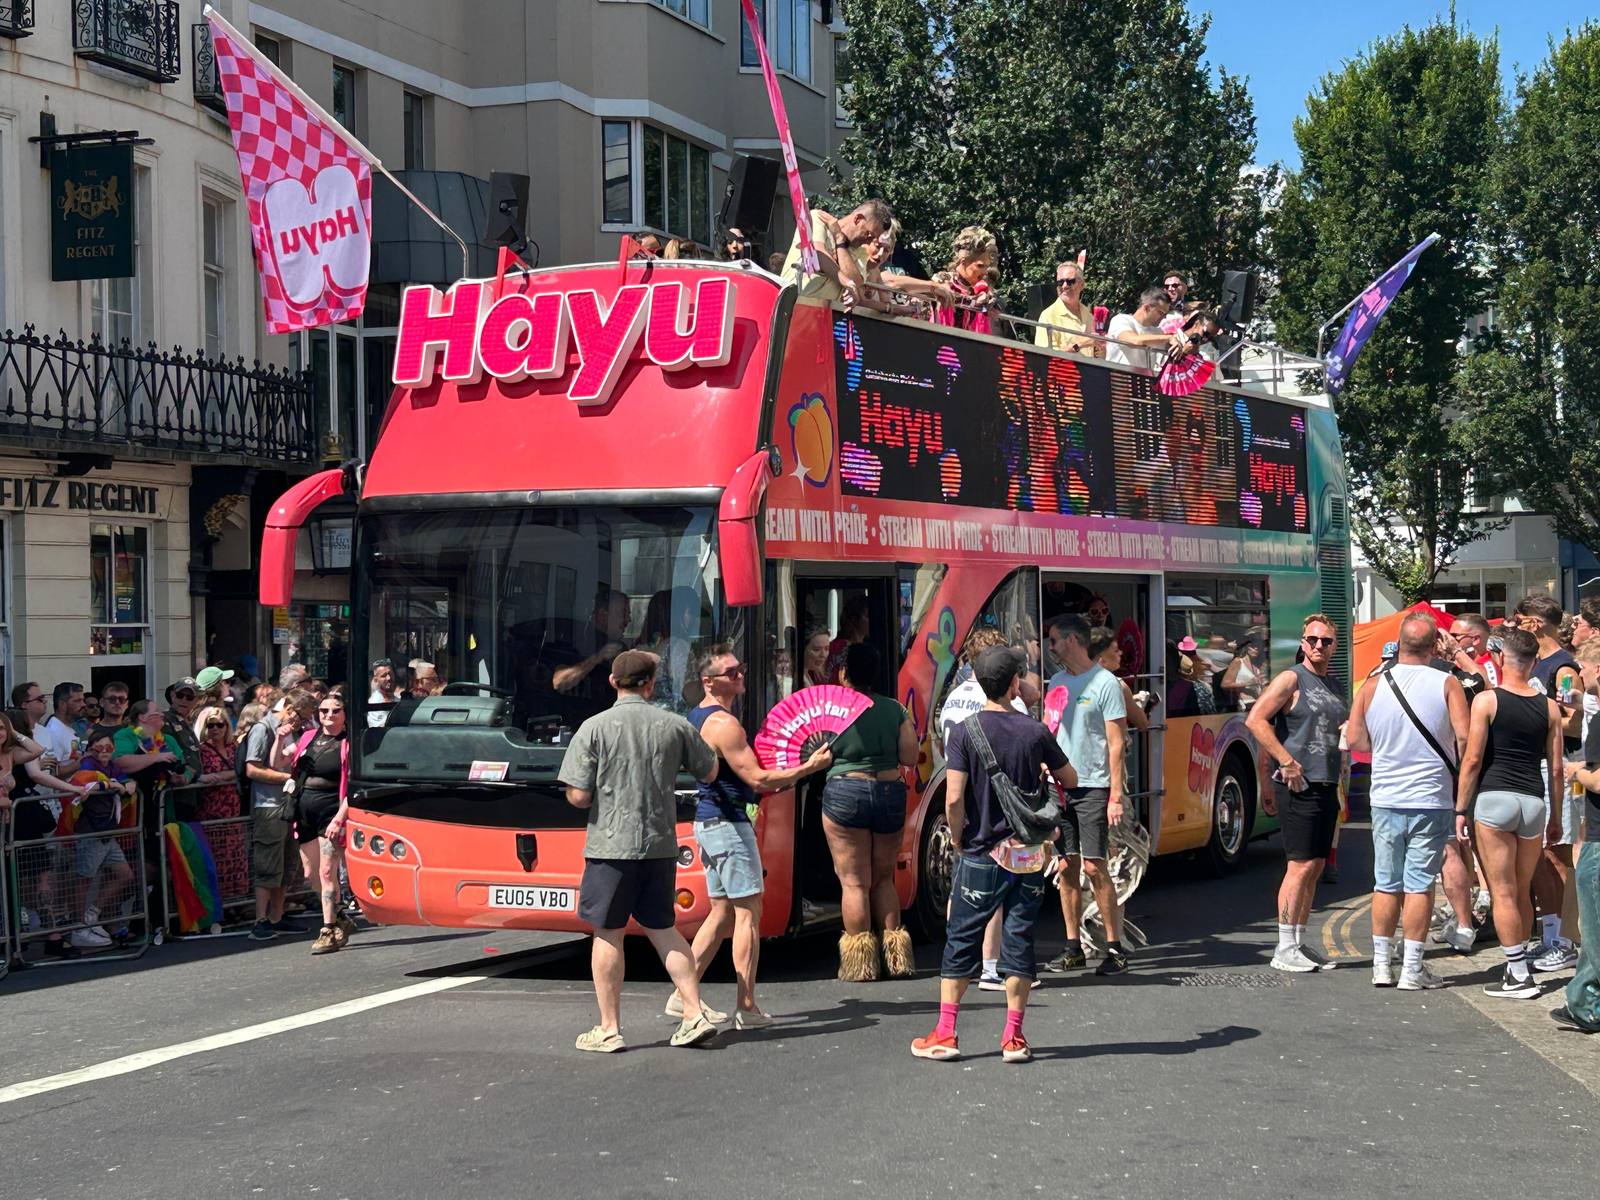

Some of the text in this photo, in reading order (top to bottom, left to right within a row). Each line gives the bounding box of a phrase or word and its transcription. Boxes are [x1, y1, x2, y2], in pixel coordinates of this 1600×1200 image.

[66, 244, 116, 259] REGENT
[77, 227, 105, 240] FITZ
[392, 277, 734, 403] Hayu
[859, 389, 943, 468] Hayu
[0, 477, 159, 514] FITZ REGENT
[799, 509, 832, 543] WITH
[834, 511, 868, 545] PRIDE
[879, 514, 923, 548] STREAM
[925, 518, 952, 549] WITH
[953, 521, 983, 551] PRIDE
[991, 524, 1029, 554] STREAM
[1030, 527, 1054, 555] WITH
[1055, 529, 1080, 557] PRIDE
[1087, 530, 1120, 558] STREAM
[1121, 532, 1142, 559] WITH
[1142, 534, 1165, 560] PRIDE
[495, 889, 568, 908] EU05 VBO
